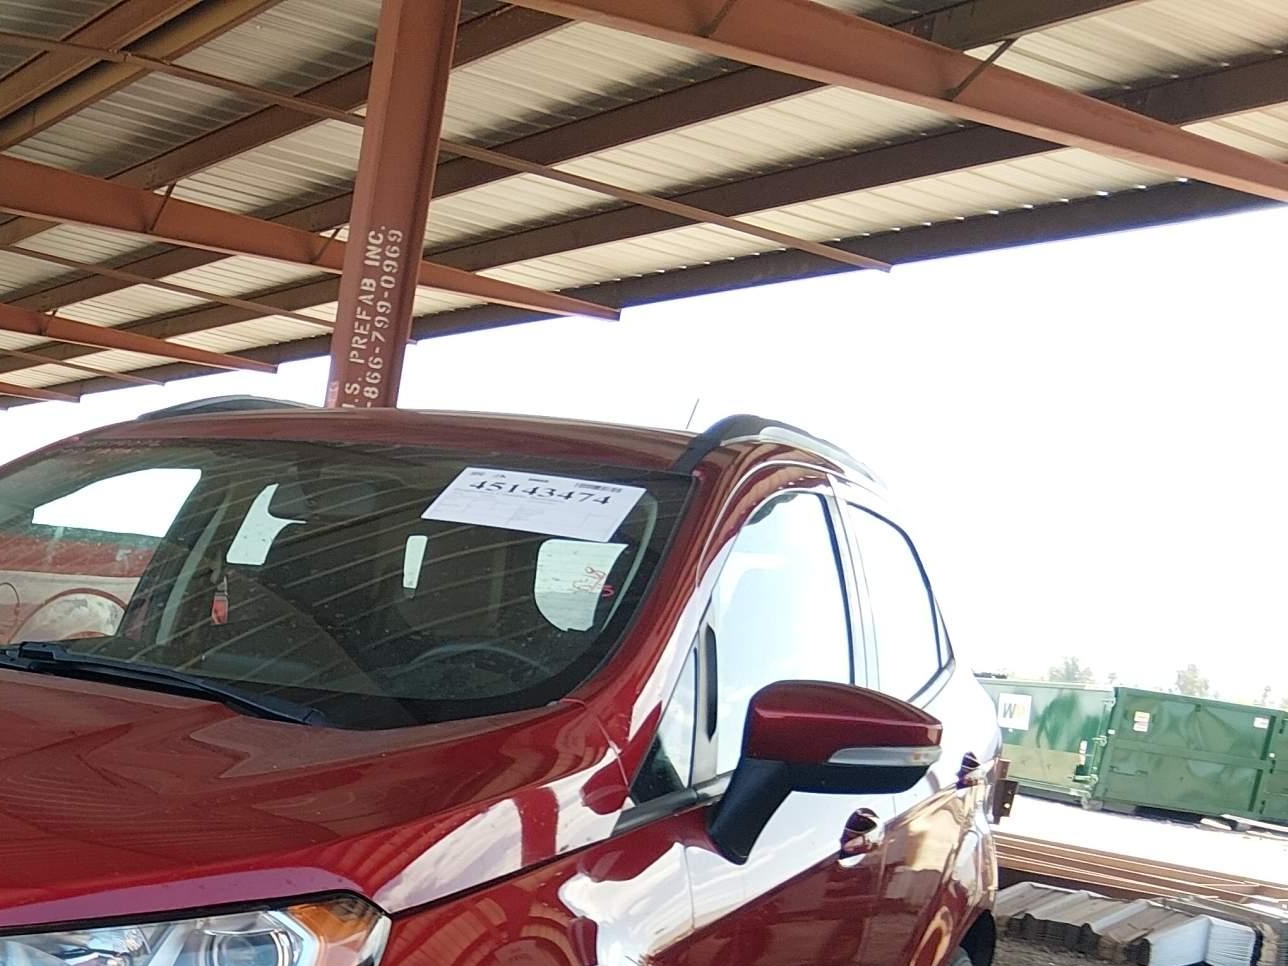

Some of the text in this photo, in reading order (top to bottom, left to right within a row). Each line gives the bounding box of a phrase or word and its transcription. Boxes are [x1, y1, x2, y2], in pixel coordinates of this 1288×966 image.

[349, 277, 377, 365] PREFAB
[364, 225, 386, 267] INC.
[363, 229, 403, 408] -866-799-0969
[468, 480, 612, 505] 45143474
